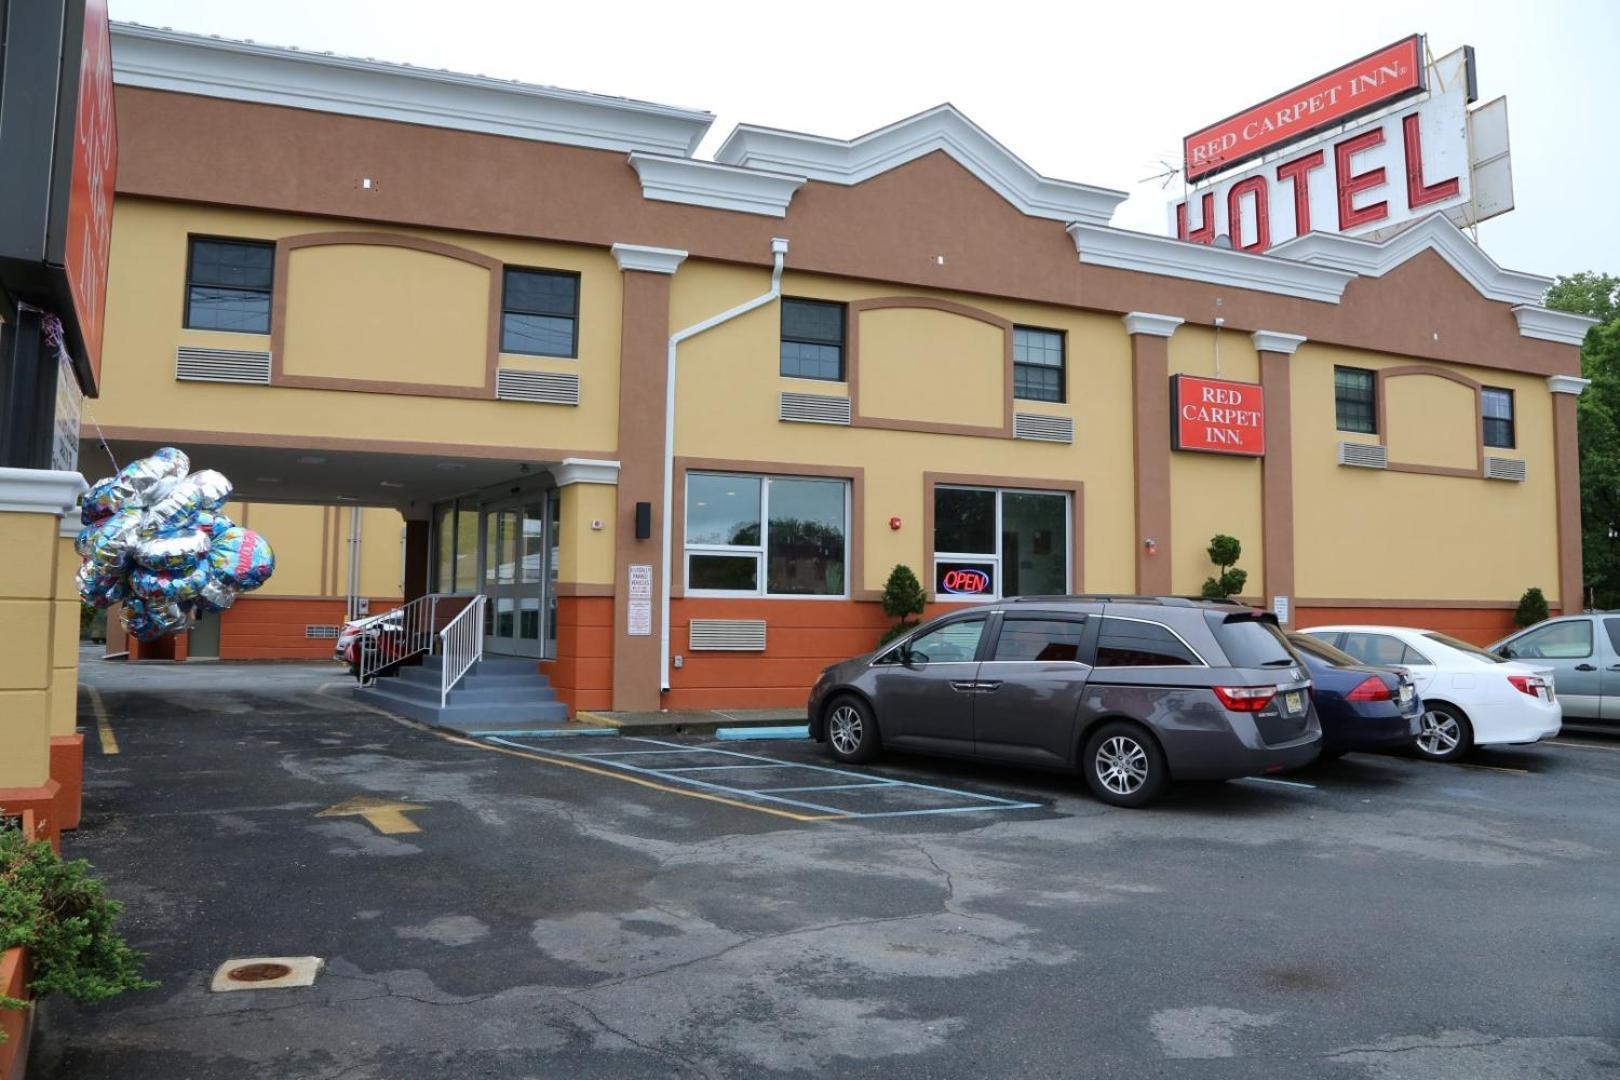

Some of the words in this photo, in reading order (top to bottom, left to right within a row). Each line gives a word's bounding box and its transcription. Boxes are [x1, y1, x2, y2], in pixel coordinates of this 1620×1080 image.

[1192, 132, 1238, 164] RED
[1242, 85, 1342, 141] CARPET
[1176, 111, 1461, 254] HOTEL
[1202, 386, 1242, 405] RED
[1182, 404, 1261, 427] CARPET
[945, 570, 986, 591] OPEN
